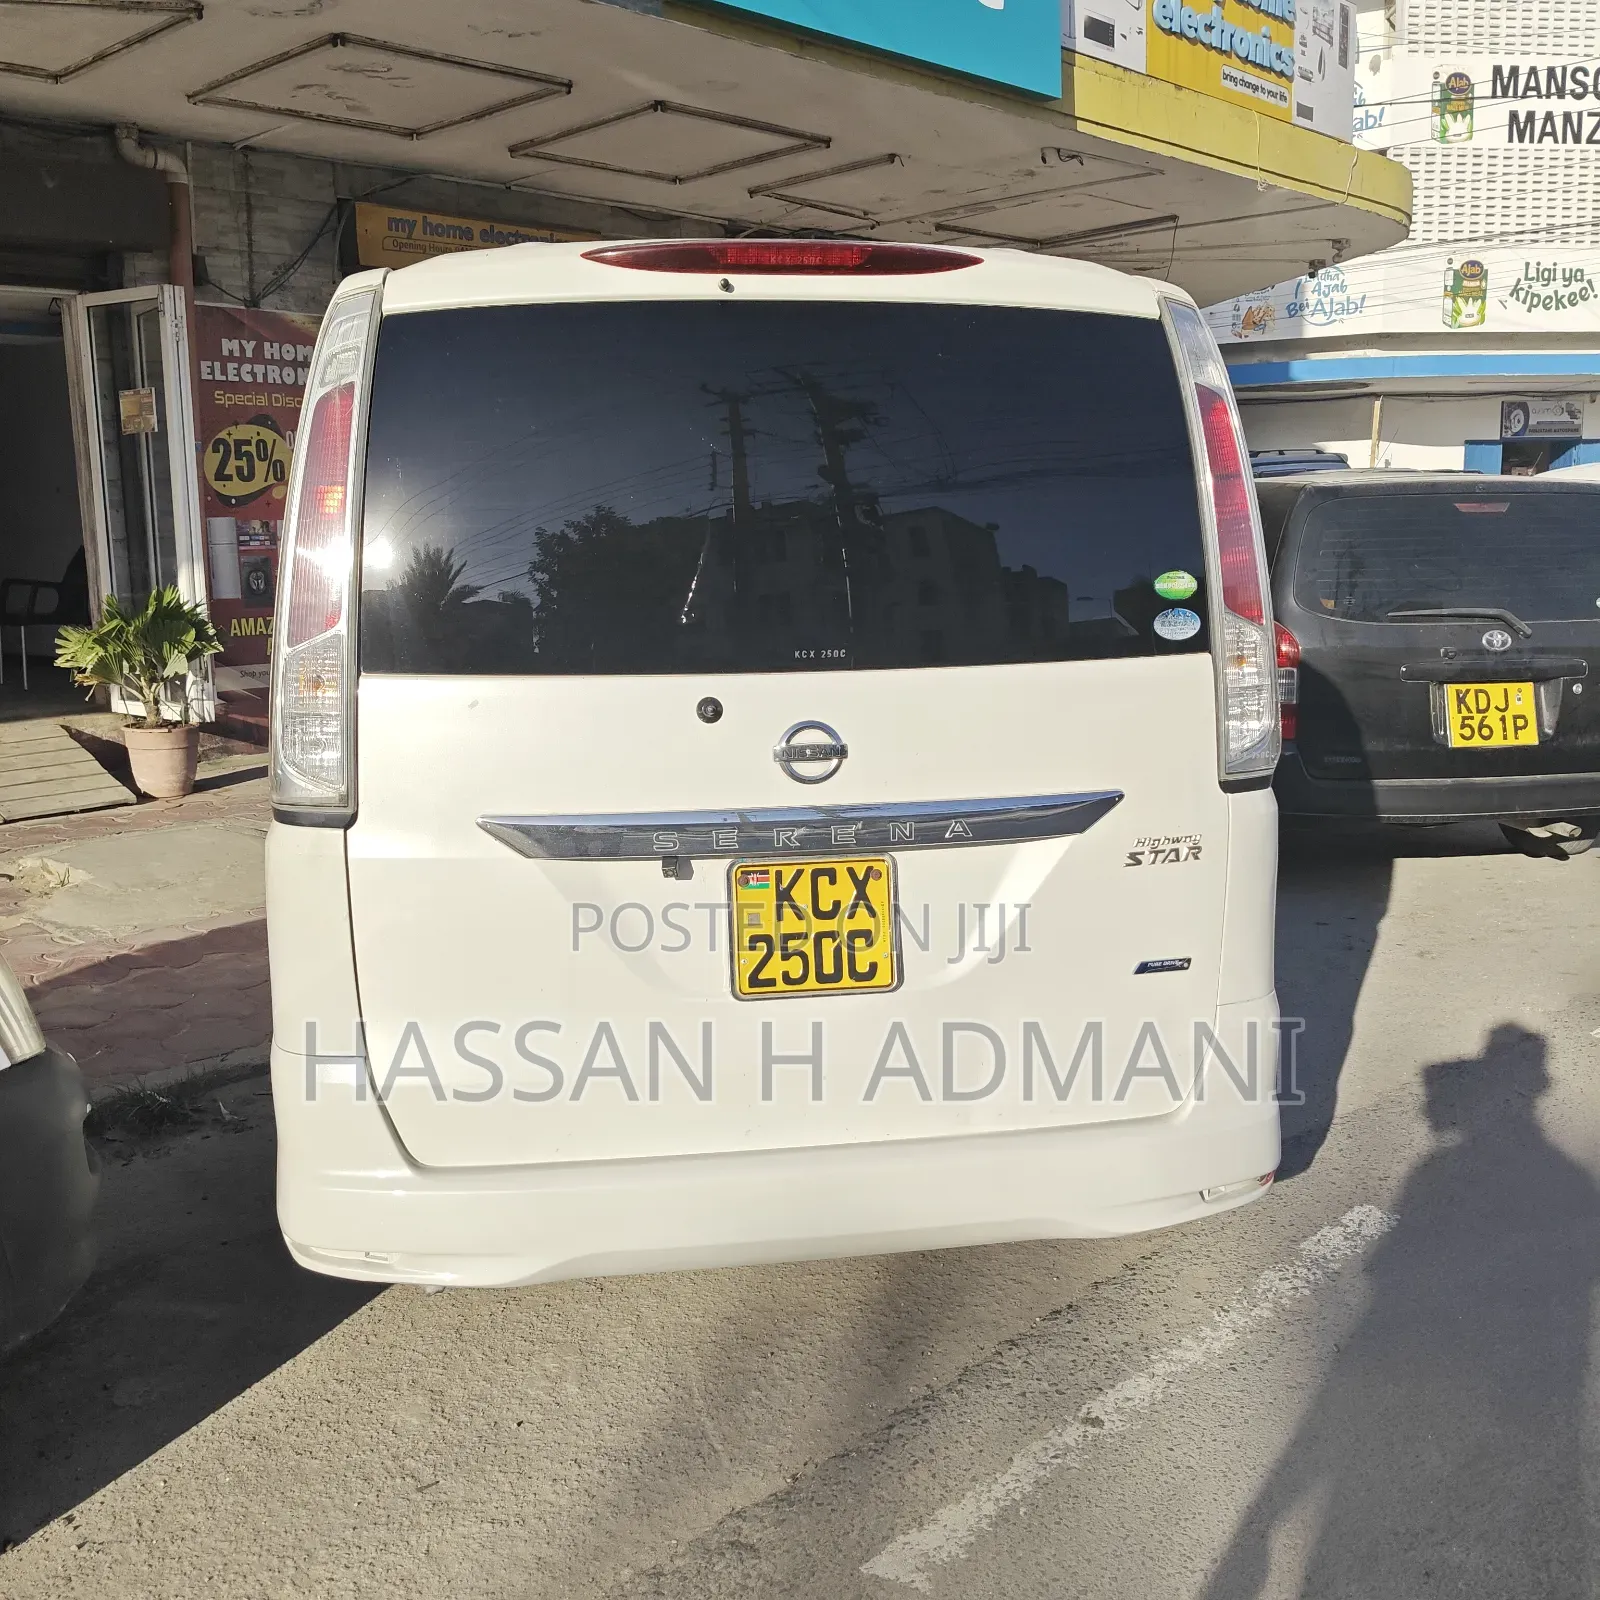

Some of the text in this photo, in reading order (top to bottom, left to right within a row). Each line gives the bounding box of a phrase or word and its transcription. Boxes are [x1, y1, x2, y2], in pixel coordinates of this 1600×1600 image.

[1152, 0, 1296, 77] electronics
[1222, 68, 1288, 104] bring change to your life
[387, 216, 417, 238] my
[422, 215, 474, 241] home
[392, 238, 427, 254] Opening
[1524, 261, 1585, 288] Ligi ya
[1285, 298, 1310, 318] Bei
[1508, 277, 1599, 314] kipekee!
[221, 338, 314, 363] MY HOM
[200, 360, 309, 386] ELECTRON
[214, 390, 303, 409] Special Disc
[211, 437, 286, 483] 25%
[230, 616, 276, 637] AMAZ
[794, 649, 846, 659] KCX 250C
[240, 669, 257, 678] Shop
[1455, 687, 1510, 714] KDJ
[1458, 713, 1529, 741] 561P
[782, 746, 842, 759] NISSAN
[652, 818, 973, 852] SERENA
[1122, 845, 1203, 868] STAR
[774, 865, 878, 922] KCX
[747, 928, 879, 989] 250C
